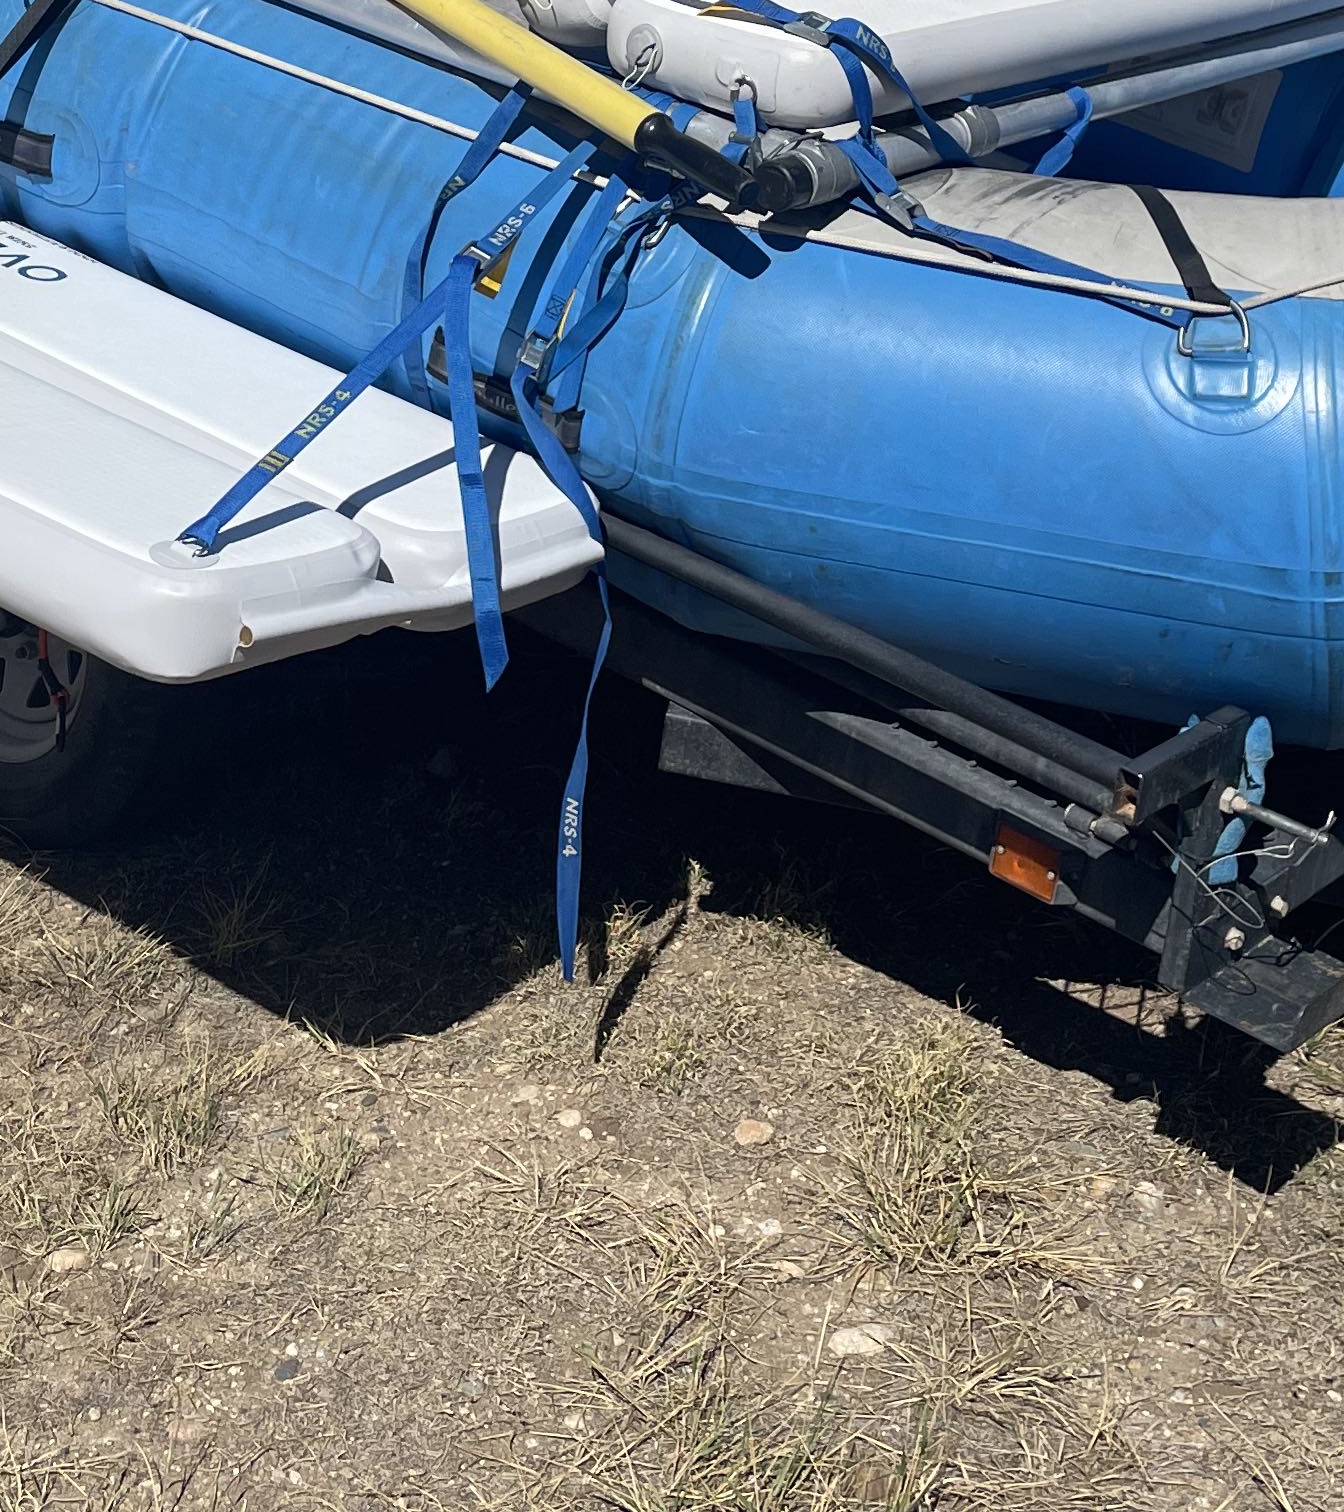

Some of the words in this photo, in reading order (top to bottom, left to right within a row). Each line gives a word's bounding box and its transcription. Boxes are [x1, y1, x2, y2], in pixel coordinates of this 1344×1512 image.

[488, 203, 536, 246] NRS-6
[294, 389, 353, 439] NRS-4
[562, 797, 579, 857] NRS-4
